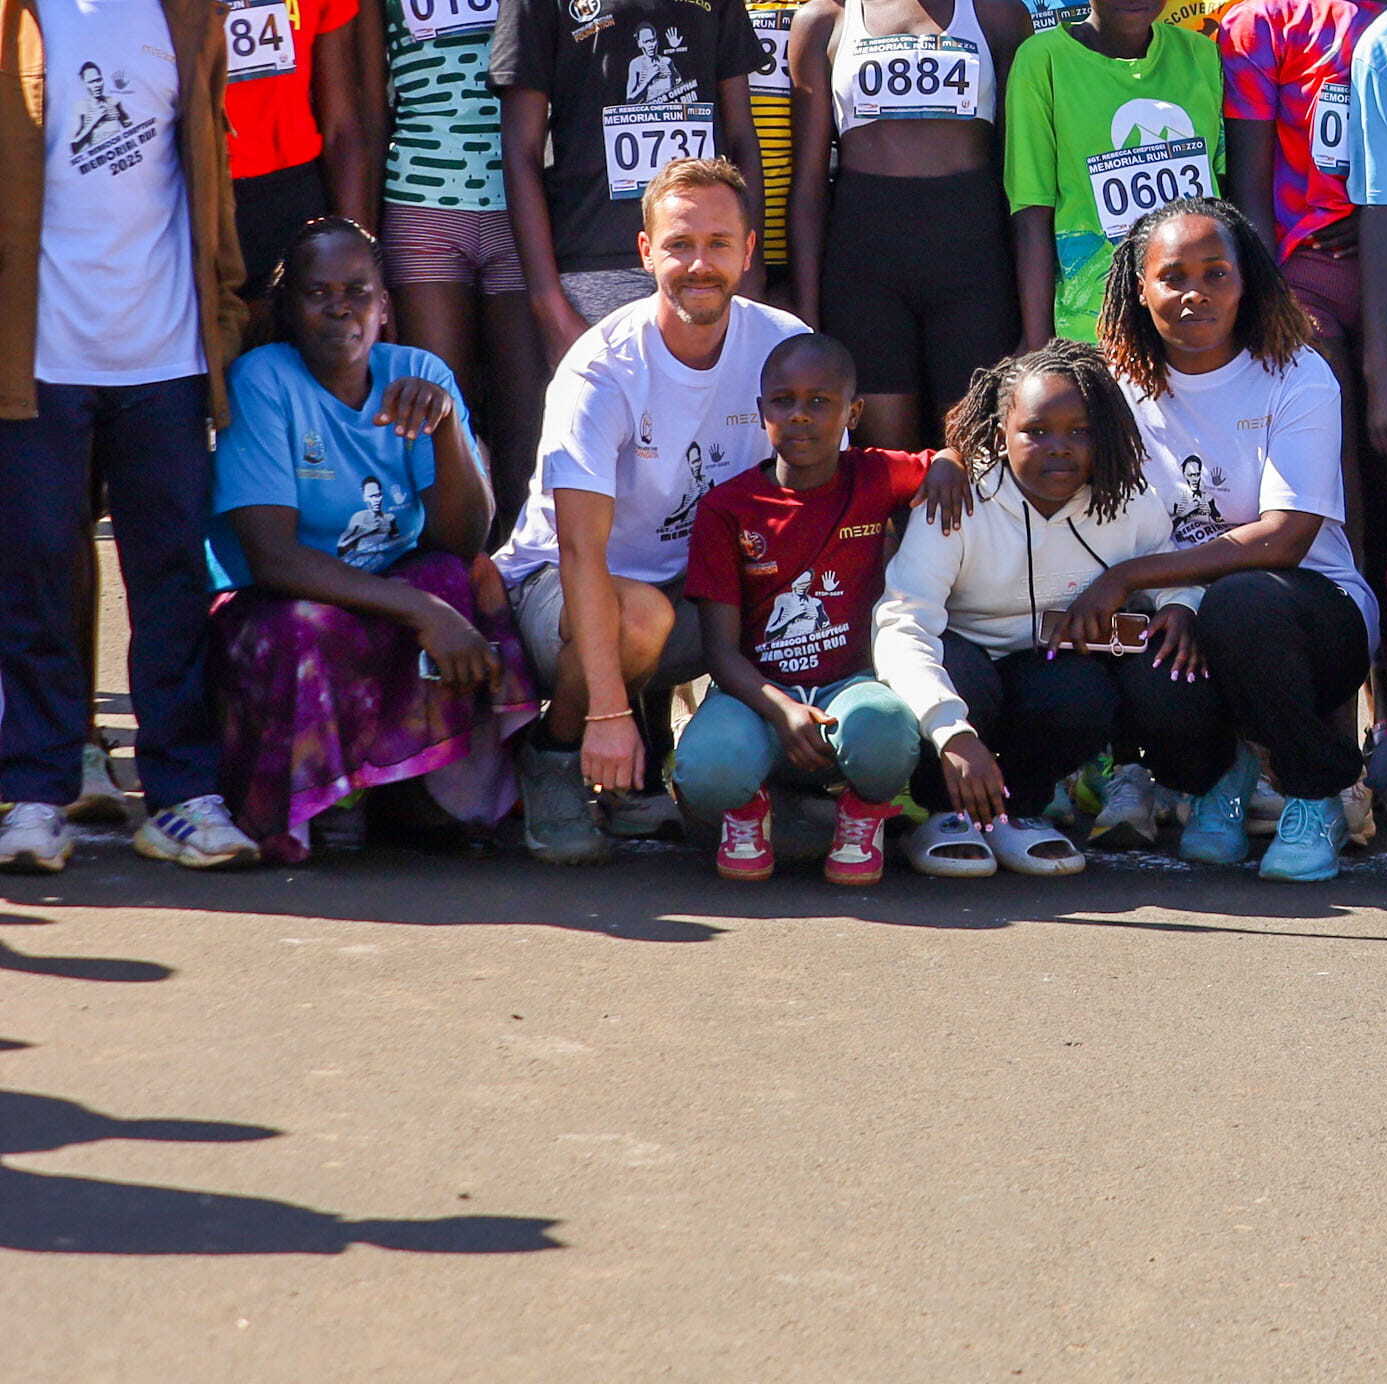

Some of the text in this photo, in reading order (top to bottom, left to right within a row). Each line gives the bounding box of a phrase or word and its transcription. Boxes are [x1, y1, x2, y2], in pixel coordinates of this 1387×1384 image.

[230, 13, 284, 57] 84
[752, 19, 776, 29] RUN
[1032, 17, 1057, 30] RUN
[912, 39, 936, 50] RUN
[858, 56, 970, 97] 0884
[603, 111, 684, 125] MEMORIAL RUN
[614, 128, 708, 171] 0737
[1102, 149, 1132, 161] REBECCA
[1172, 141, 1204, 153] mezzo
[109, 150, 143, 176] 2025
[1088, 151, 1169, 174] MEMORIAL RUN
[1102, 164, 1204, 217] 0603
[760, 634, 848, 663] MEMORIAL RUN
[778, 655, 819, 673] 2025
